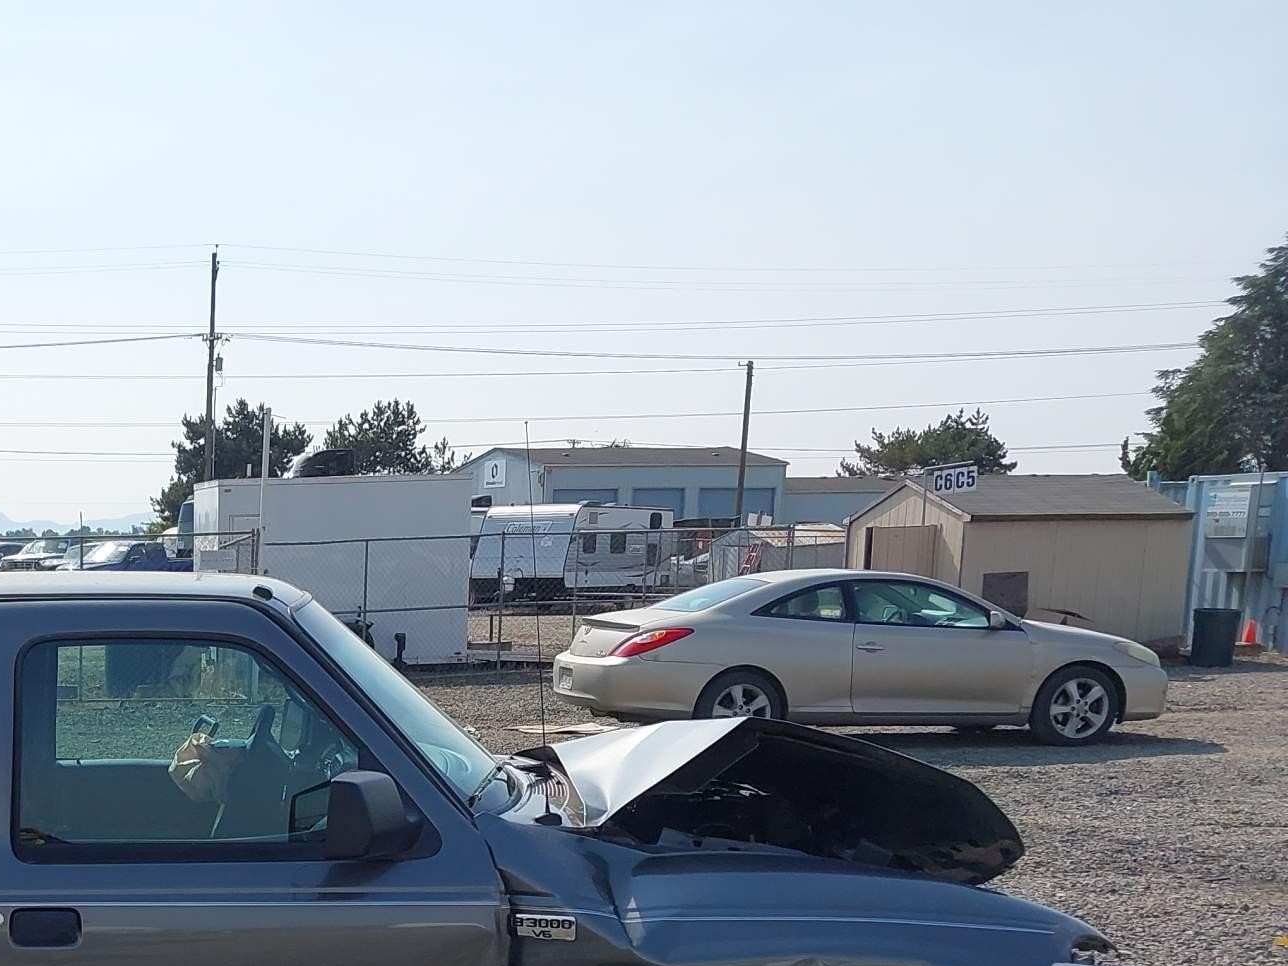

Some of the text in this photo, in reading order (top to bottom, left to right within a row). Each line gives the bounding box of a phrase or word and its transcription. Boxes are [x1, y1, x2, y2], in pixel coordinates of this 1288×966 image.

[934, 470, 975, 491] C6 C5
[531, 929, 553, 938] V6
